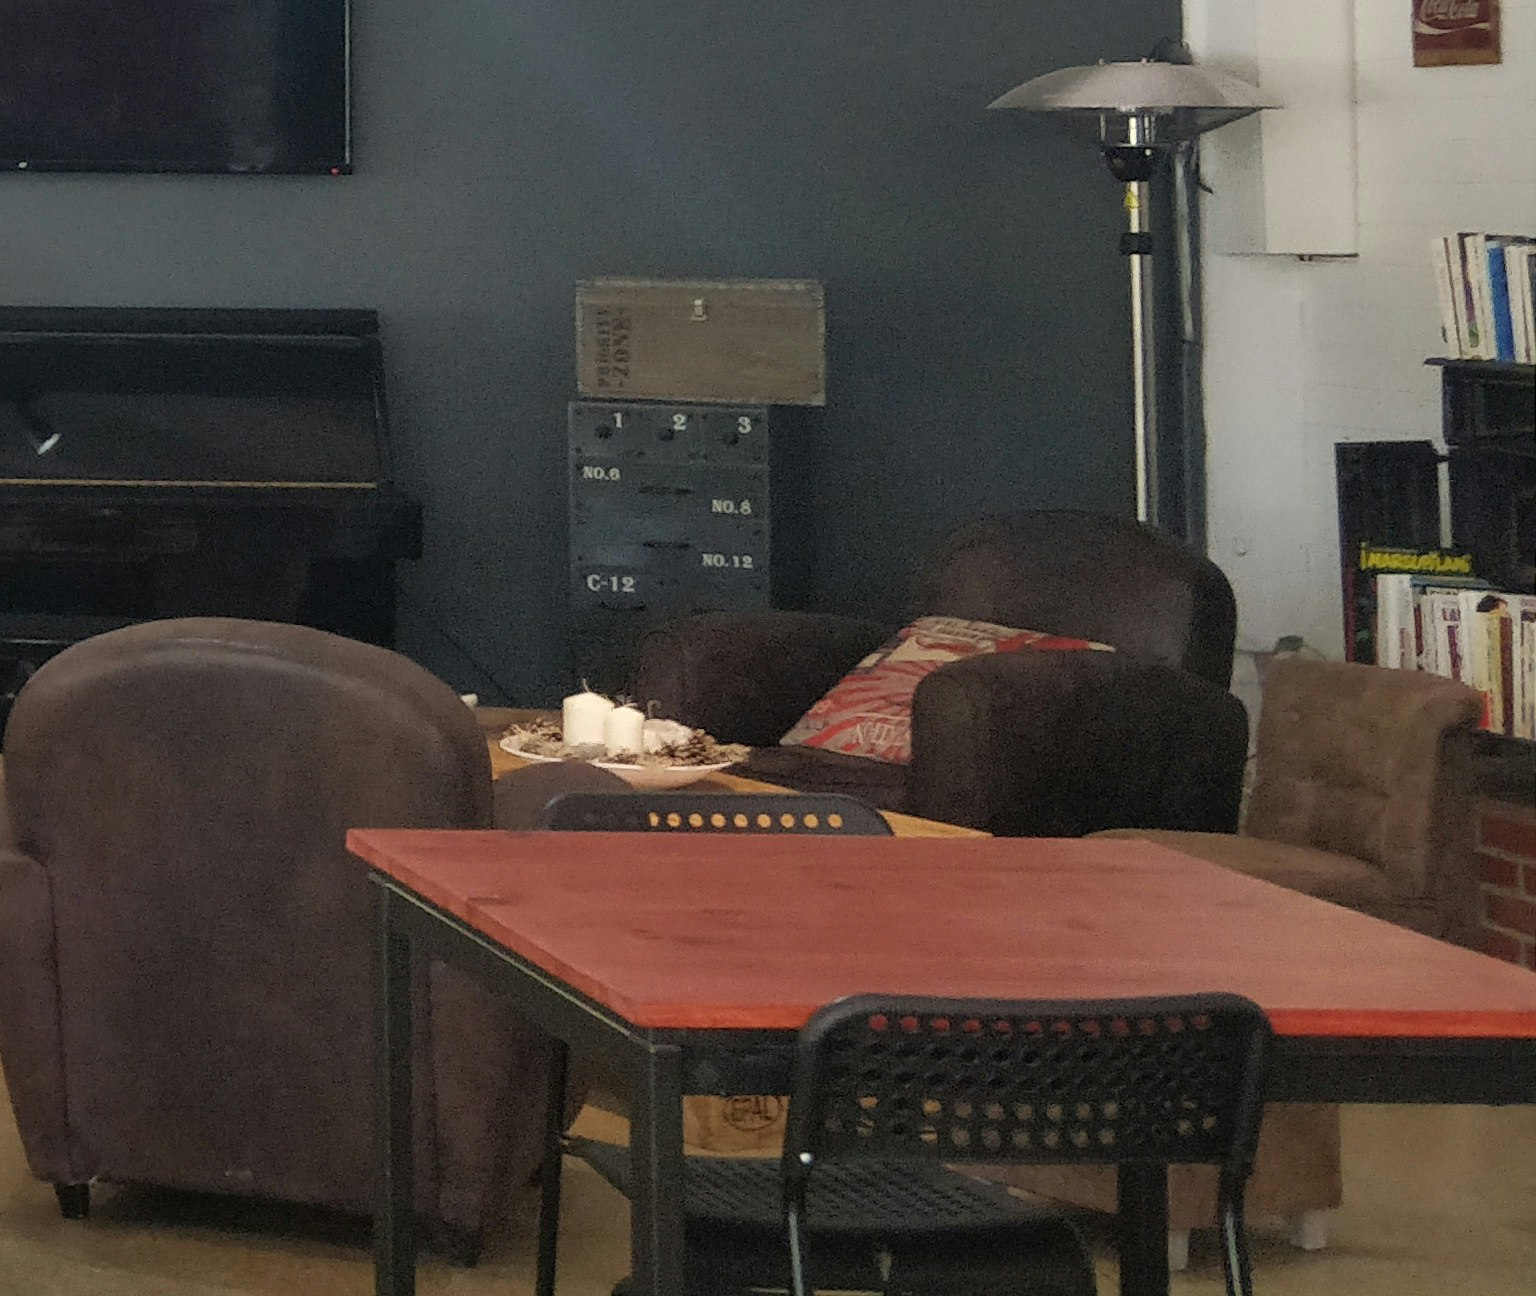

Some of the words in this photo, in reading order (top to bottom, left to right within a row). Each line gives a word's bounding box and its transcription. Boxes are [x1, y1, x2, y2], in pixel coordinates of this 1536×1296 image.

[613, 412, 623, 429] 1
[672, 413, 687, 431] 2
[737, 416, 752, 434] 3
[586, 574, 636, 593] C-12
